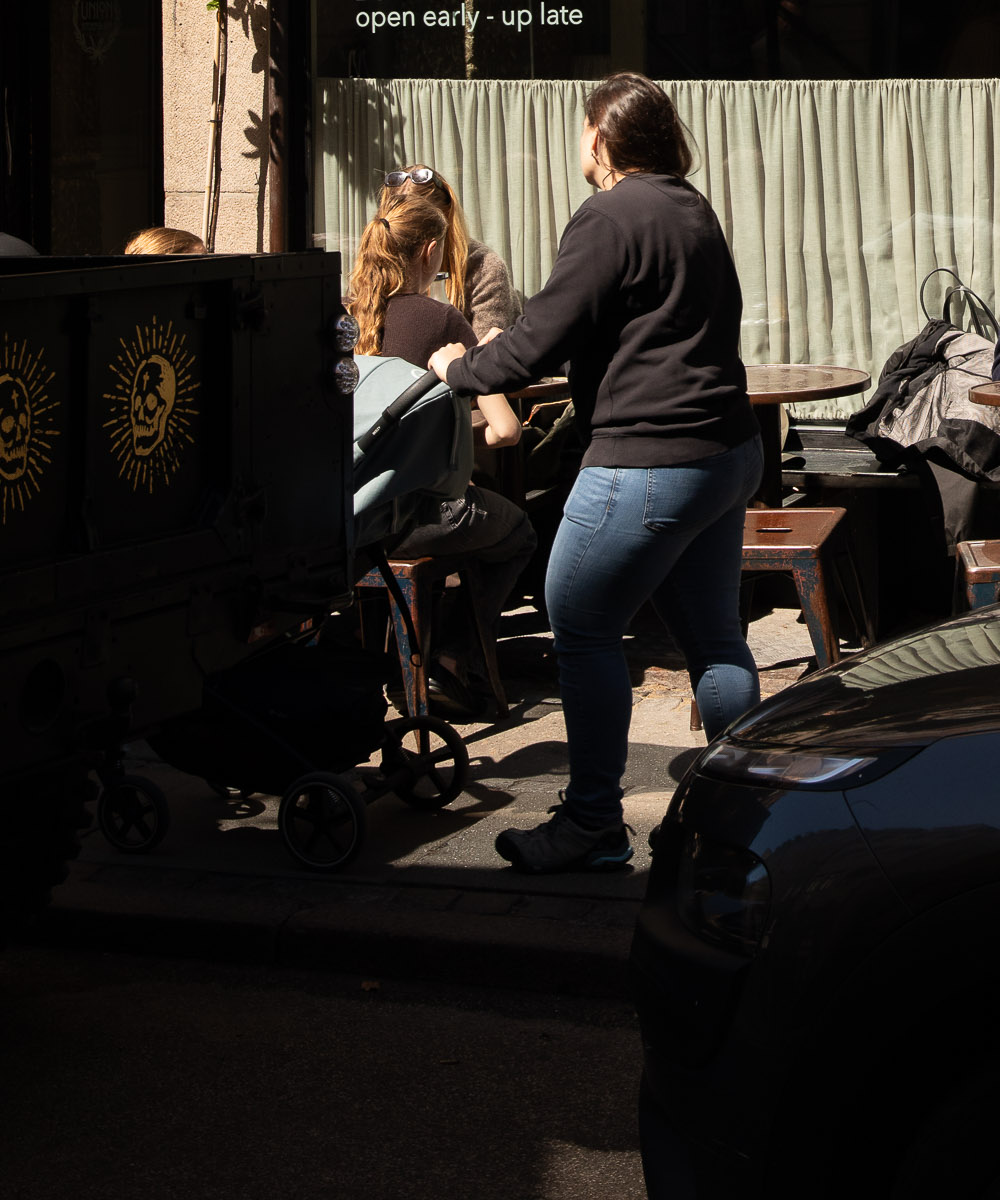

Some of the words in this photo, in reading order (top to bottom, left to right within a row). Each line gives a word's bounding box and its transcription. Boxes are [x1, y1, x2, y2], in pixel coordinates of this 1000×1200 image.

[355, 9, 415, 33] open
[423, 2, 480, 33] early
[502, 8, 533, 32] up
[540, 1, 583, 26] late
